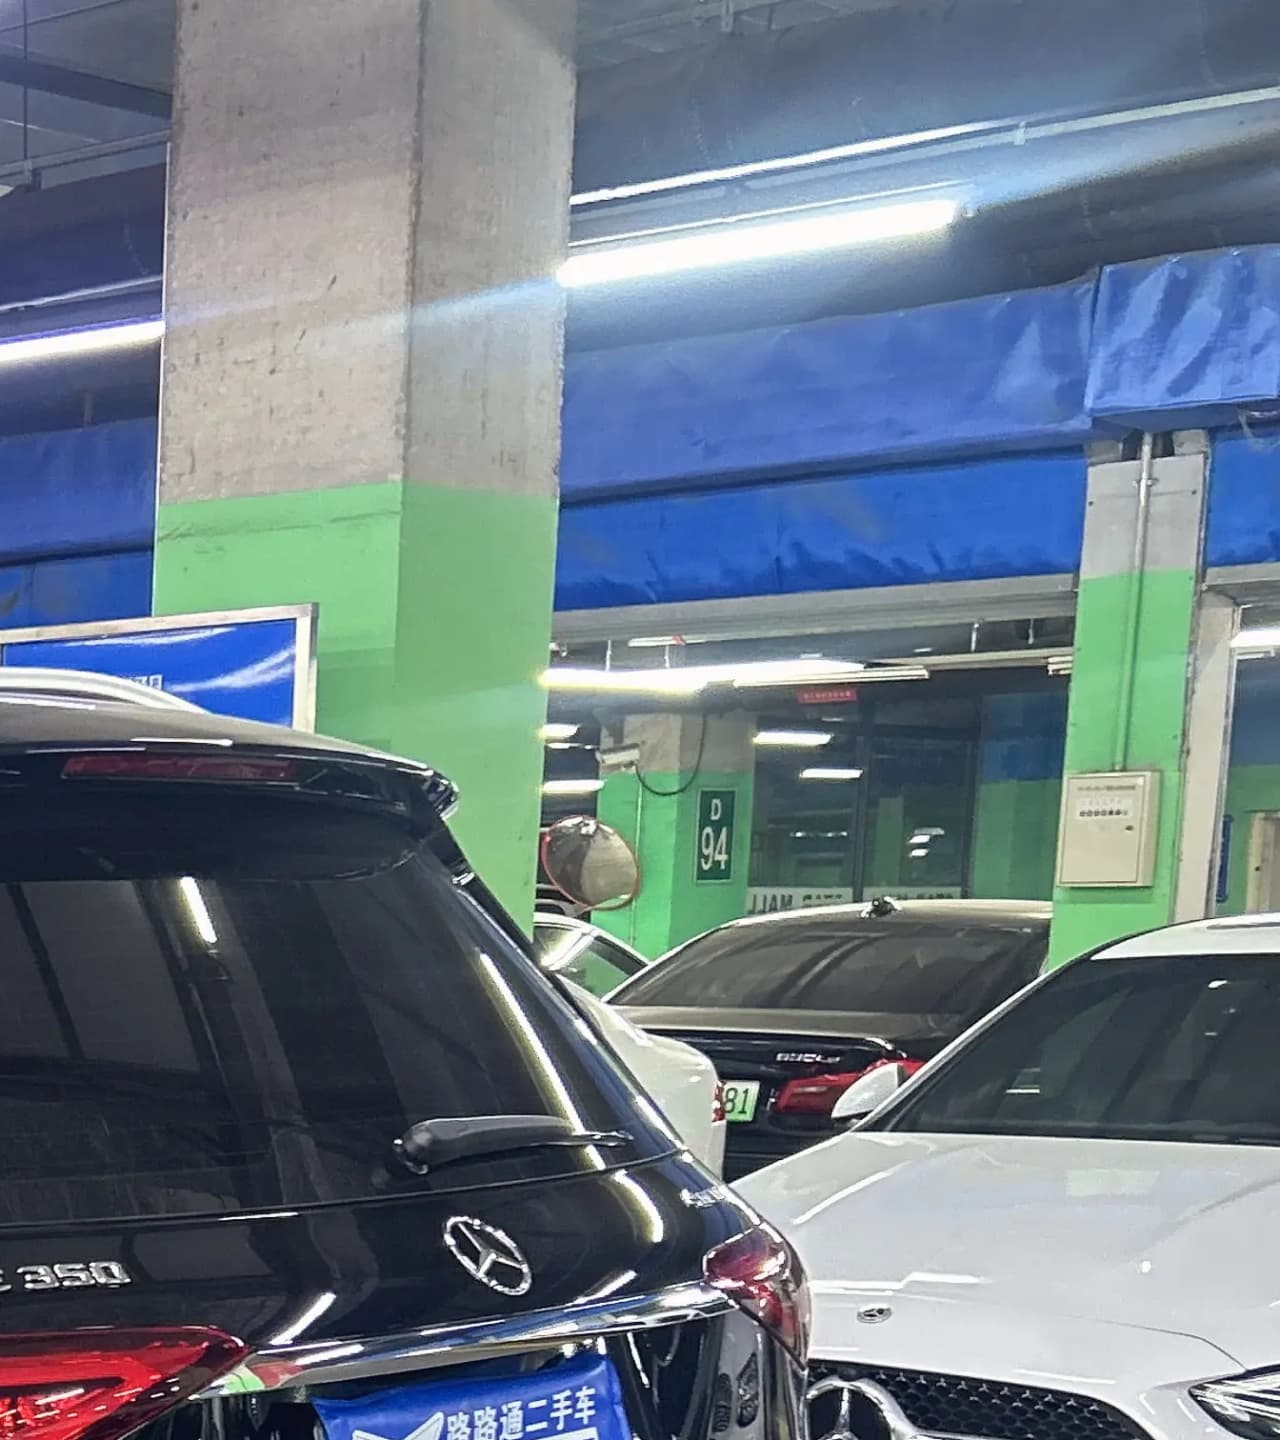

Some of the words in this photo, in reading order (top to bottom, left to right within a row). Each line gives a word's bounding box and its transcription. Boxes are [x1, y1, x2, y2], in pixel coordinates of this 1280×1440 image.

[710, 798, 722, 820] D
[701, 826, 729, 870] 94
[16, 1260, 132, 1290] 350
